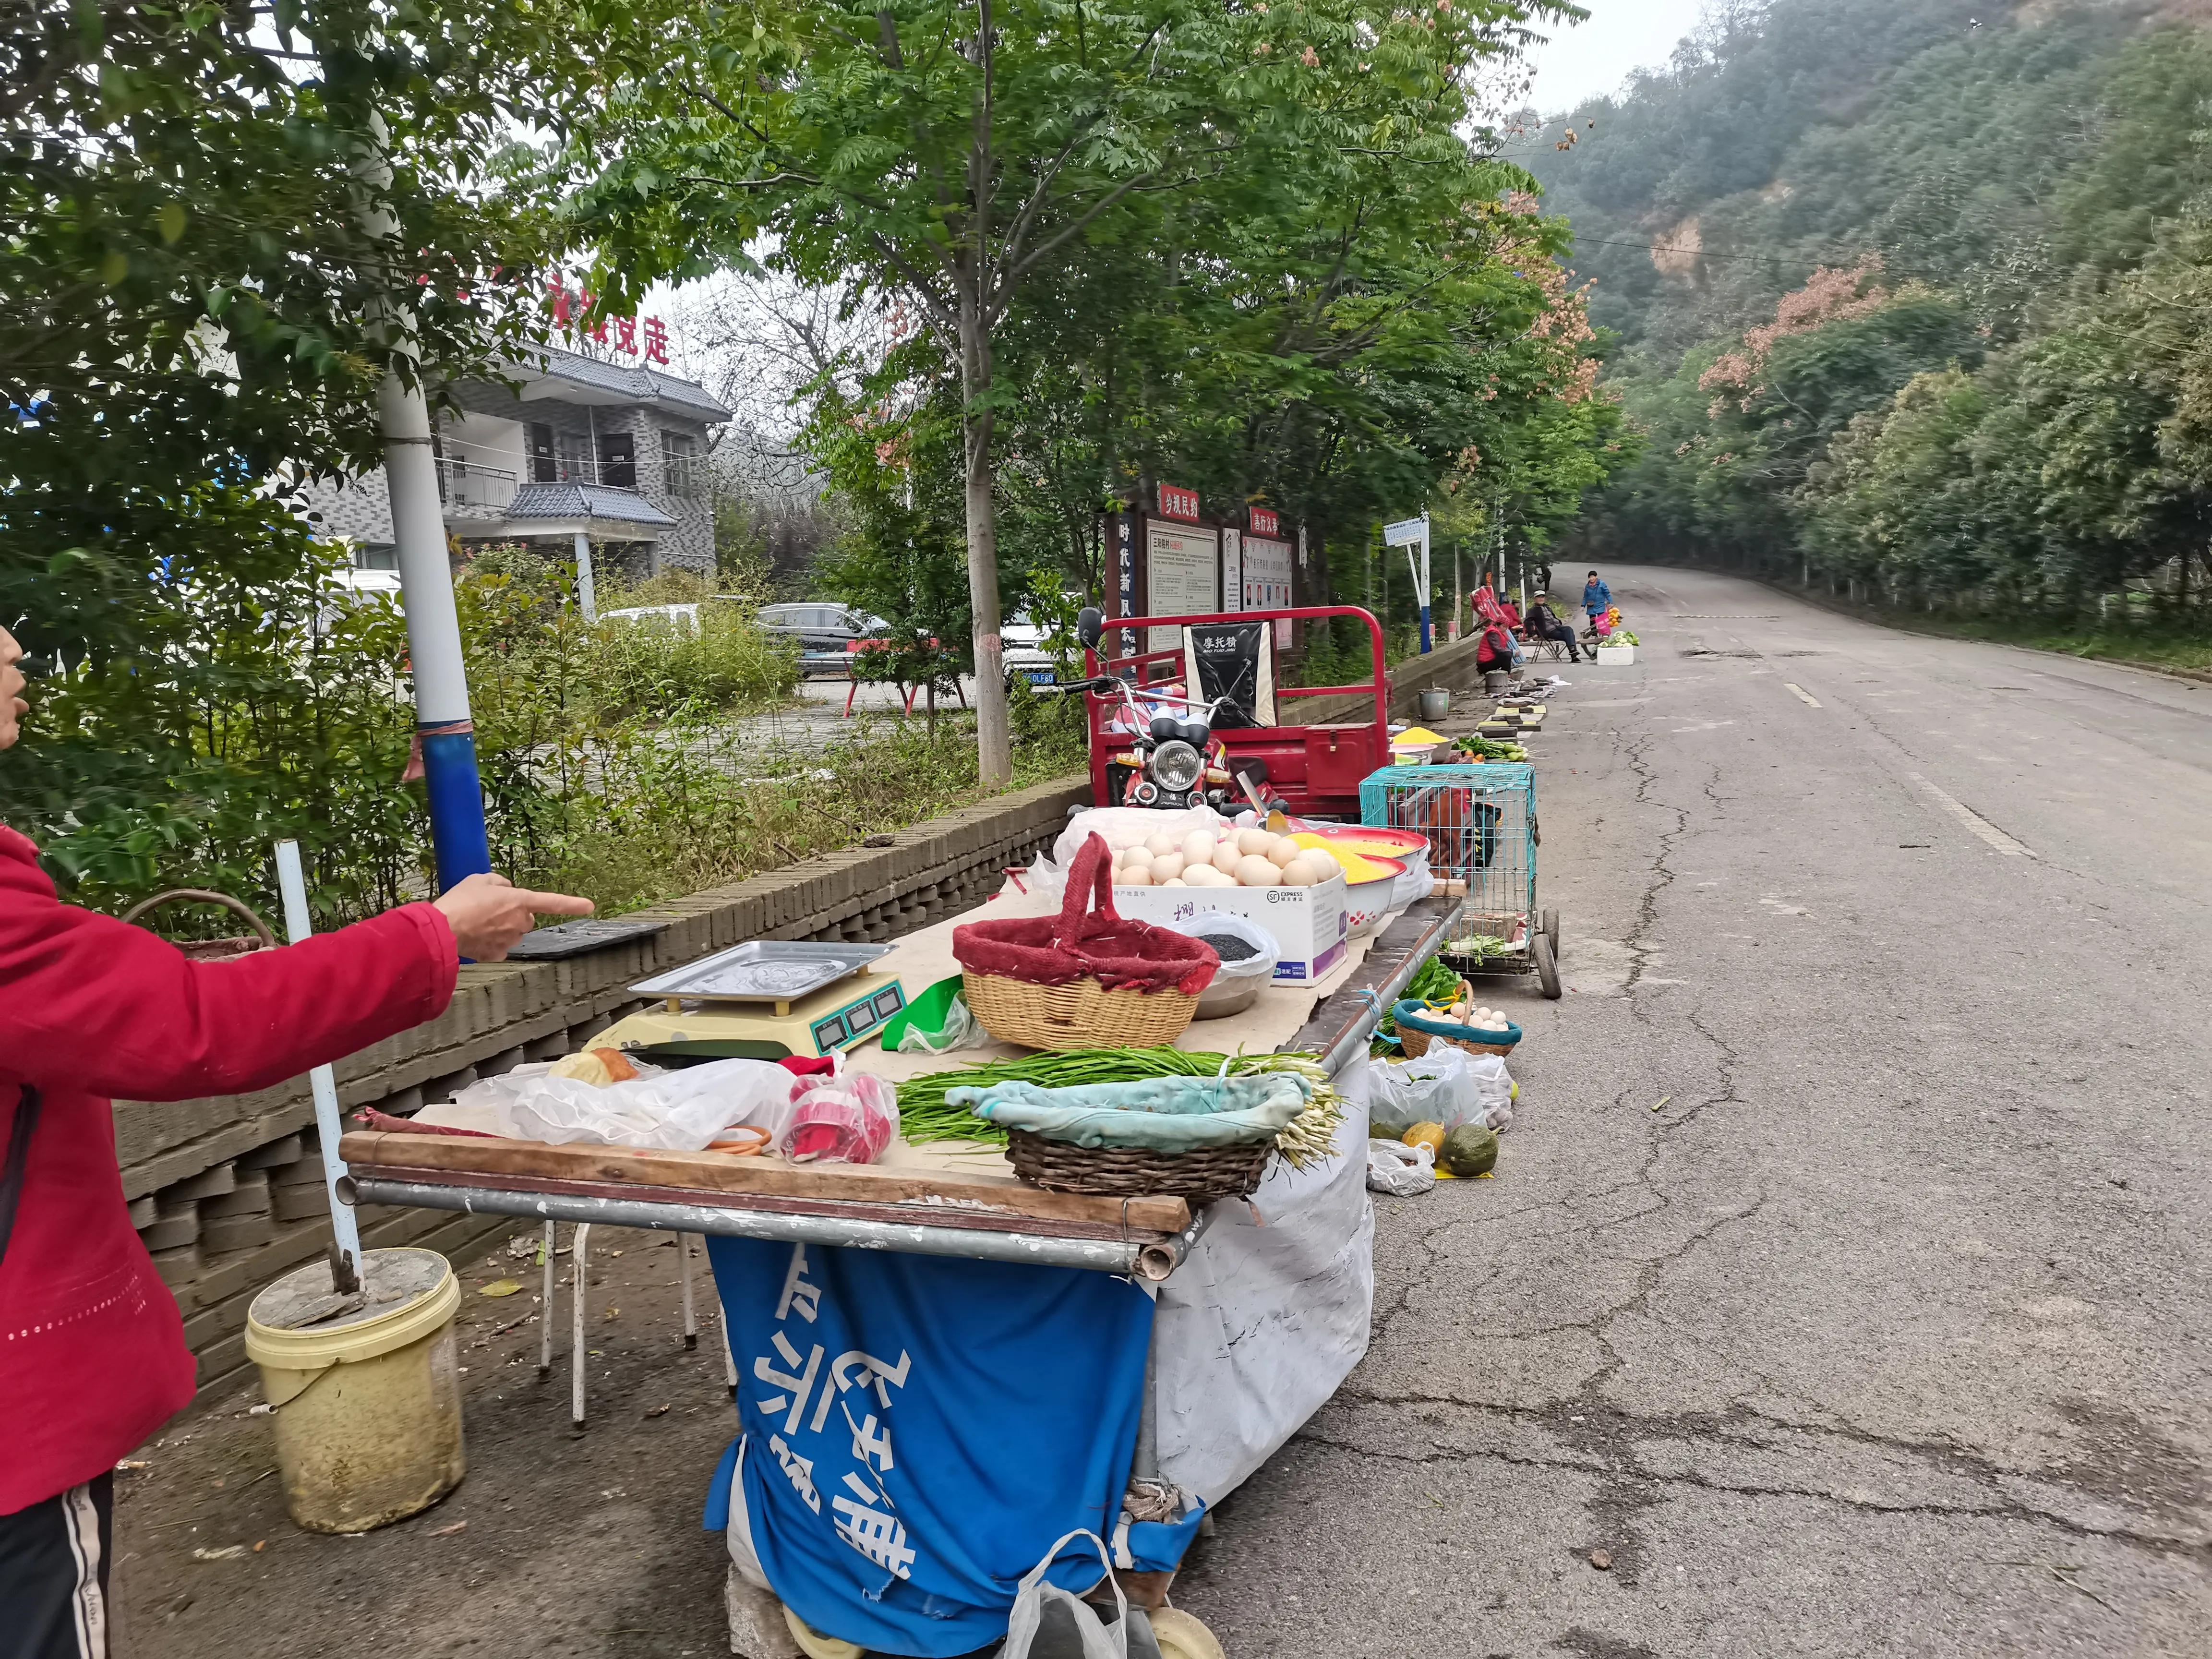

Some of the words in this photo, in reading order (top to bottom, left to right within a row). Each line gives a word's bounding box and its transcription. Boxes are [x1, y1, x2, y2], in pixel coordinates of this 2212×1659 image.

[1166, 493, 1198, 517] 乡规民约
[1254, 513, 1278, 534] 善行义举
